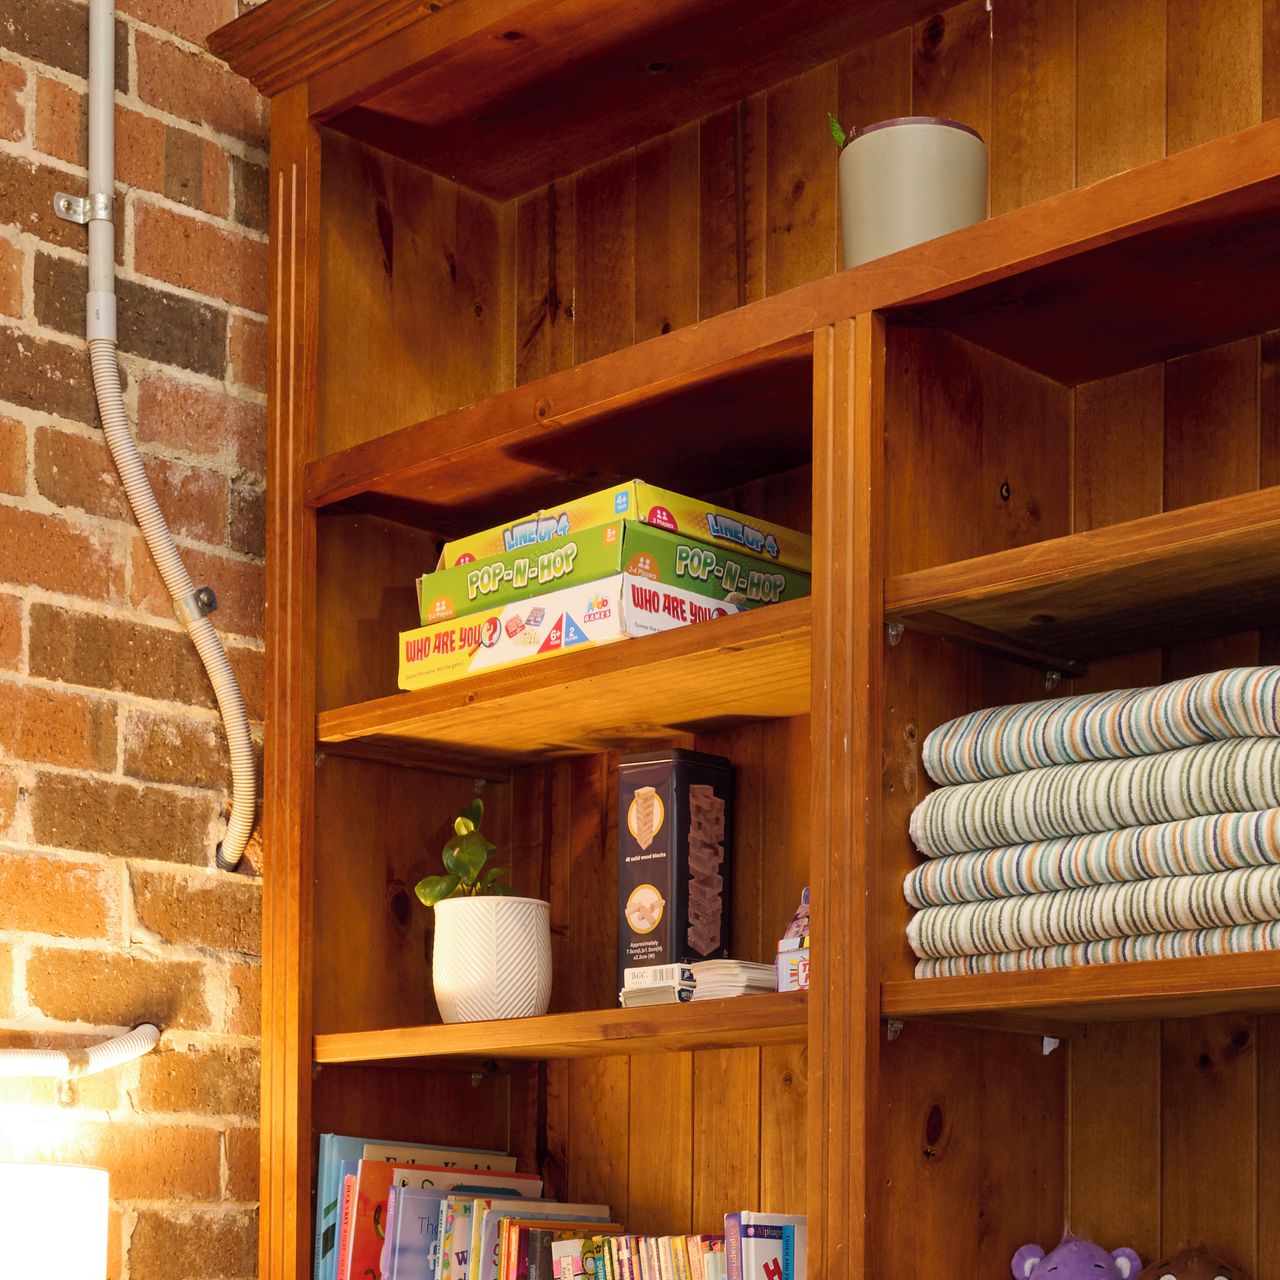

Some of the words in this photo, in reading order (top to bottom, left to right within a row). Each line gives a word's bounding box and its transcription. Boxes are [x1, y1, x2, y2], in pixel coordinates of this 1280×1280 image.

[616, 495, 626, 505] 4+
[504, 520, 537, 551] LINE
[538, 516, 557, 542] UP
[557, 512, 570, 536] 4
[706, 512, 743, 543] LINE
[743, 525, 765, 551] UP
[764, 535, 779, 559] 4
[631, 583, 660, 614] WHO
[662, 594, 687, 622] ARE
[584, 609, 611, 623] GAMES
[550, 629, 561, 640] 6+
[568, 627, 575, 636] 2
[405, 633, 431, 663] WHO
[433, 629, 455, 654] ARE
[630, 940, 659, 948] Approximately
